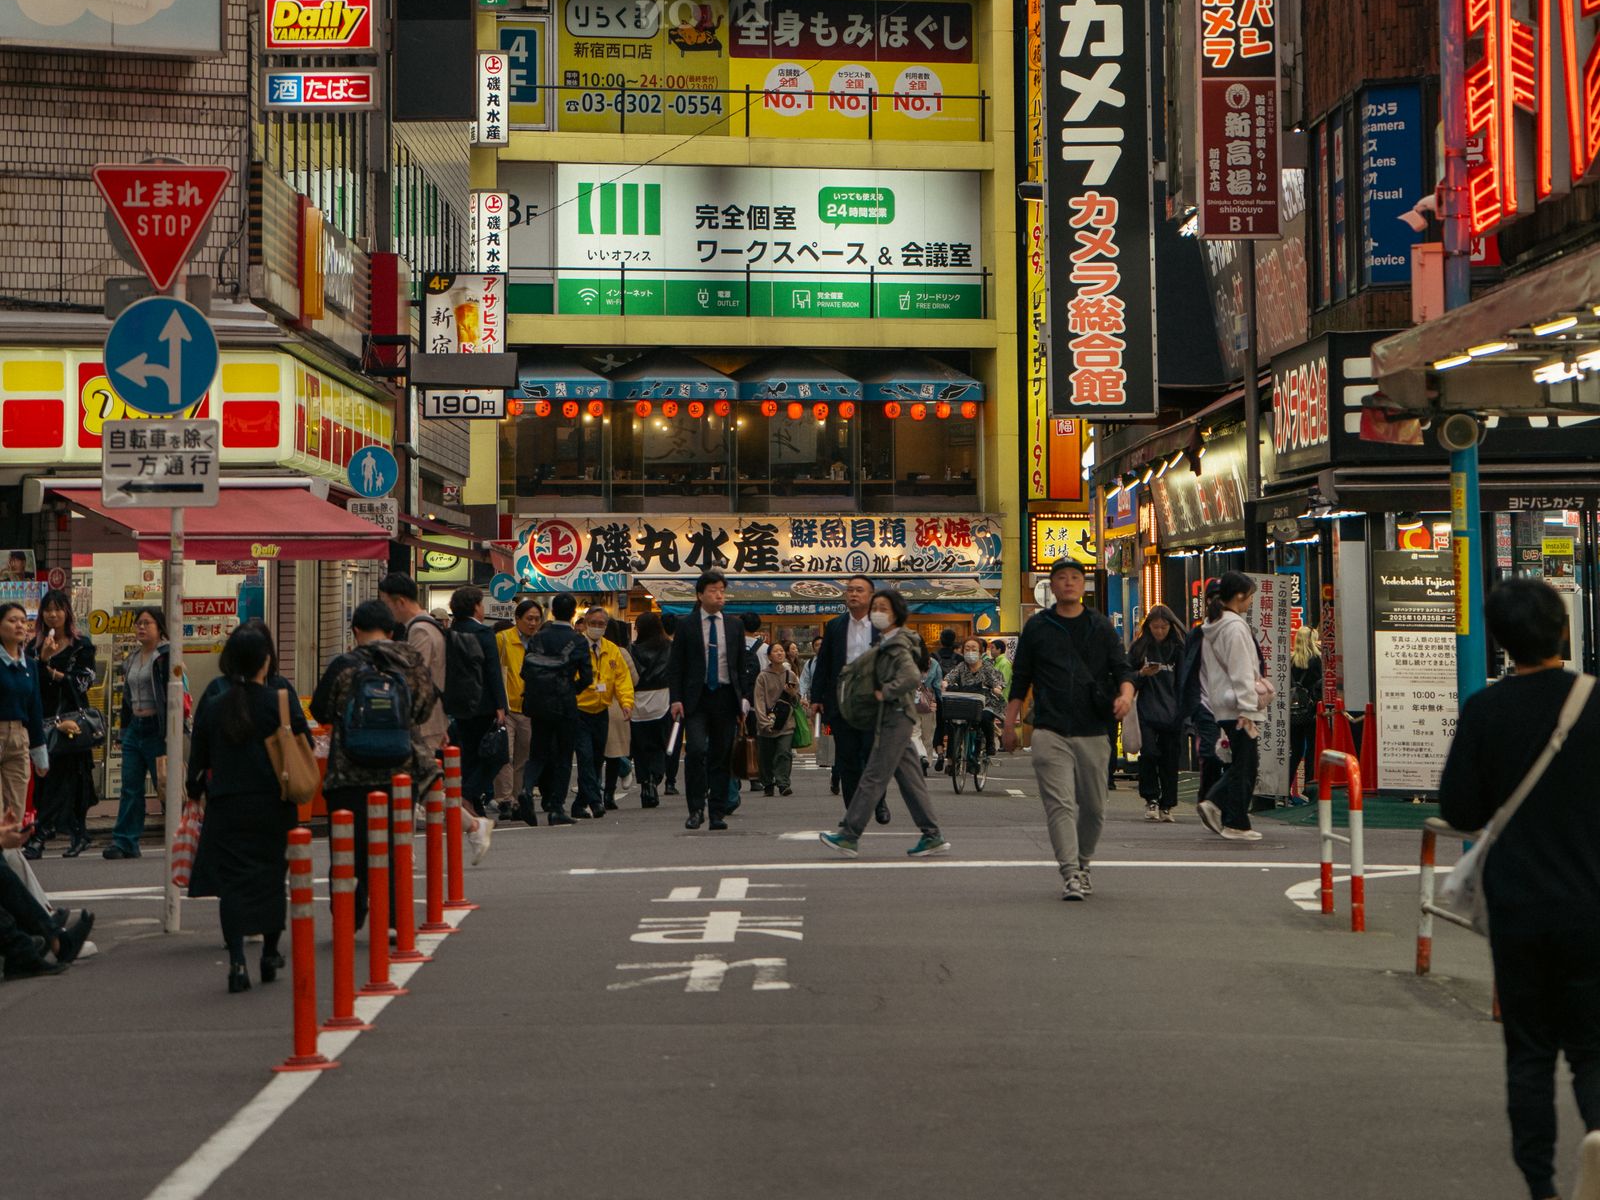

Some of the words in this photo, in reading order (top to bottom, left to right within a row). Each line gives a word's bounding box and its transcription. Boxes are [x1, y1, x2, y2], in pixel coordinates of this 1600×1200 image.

[273, 0, 365, 40] Daily
[575, 5, 649, 29] りらくる
[273, 27, 339, 40] YAMAZAKI
[737, 7, 968, 51] 全身もみほぐし
[573, 42, 652, 60] 新宿西口店
[778, 68, 800, 77] 店舗数
[838, 71, 871, 79] セラピスト数
[905, 72, 930, 80] 利用者数
[273, 80, 298, 100] 酒
[306, 79, 367, 100] たばこ
[779, 78, 799, 88] 全国
[845, 79, 864, 89] 全国
[908, 80, 927, 91] 全国
[486, 76, 500, 139] 磯丸水産
[764, 89, 813, 109] No.1
[829, 91, 877, 110] No.1
[894, 92, 942, 111] No.1
[1209, 148, 1220, 192] 新宿本店
[1370, 157, 1396, 168] Lens
[123, 180, 203, 208] 止まれ
[833, 192, 884, 202] いつでも使える
[696, 204, 797, 231] 完全個室
[827, 204, 887, 219] 24時間営業
[1220, 206, 1263, 214] shinkouyo
[137, 214, 191, 237] STOP
[486, 216, 500, 273] 磯丸水産
[697, 240, 868, 265] ワークスペース
[878, 246, 893, 266] &
[901, 241, 972, 267] 会議室
[587, 250, 651, 261] いいオフィス
[429, 275, 449, 290] 4F
[817, 292, 844, 300] 完全個室
[916, 293, 960, 301] フリードリンク
[1069, 191, 1127, 406] カメラ総合館
[432, 396, 496, 415] 190円
[110, 429, 214, 450] 自転車を除く
[111, 455, 211, 477] 一方通行
[351, 503, 394, 514] 自転車を除く
[1508, 497, 1584, 509] ヨドバシカメラ
[790, 518, 906, 548] 鮮魚貝類
[915, 518, 972, 548] 浜焼
[1045, 527, 1069, 541] 大衆
[251, 543, 281, 557] Daily
[586, 521, 779, 574] 磯丸水産
[1044, 543, 1069, 558] 酒場
[1290, 574, 1300, 604] カメラ
[1380, 575, 1424, 586] Yodobashi
[183, 601, 236, 613] 銀行ATM
[88, 609, 138, 634] Dail
[1412, 704, 1443, 712] 年中無休
